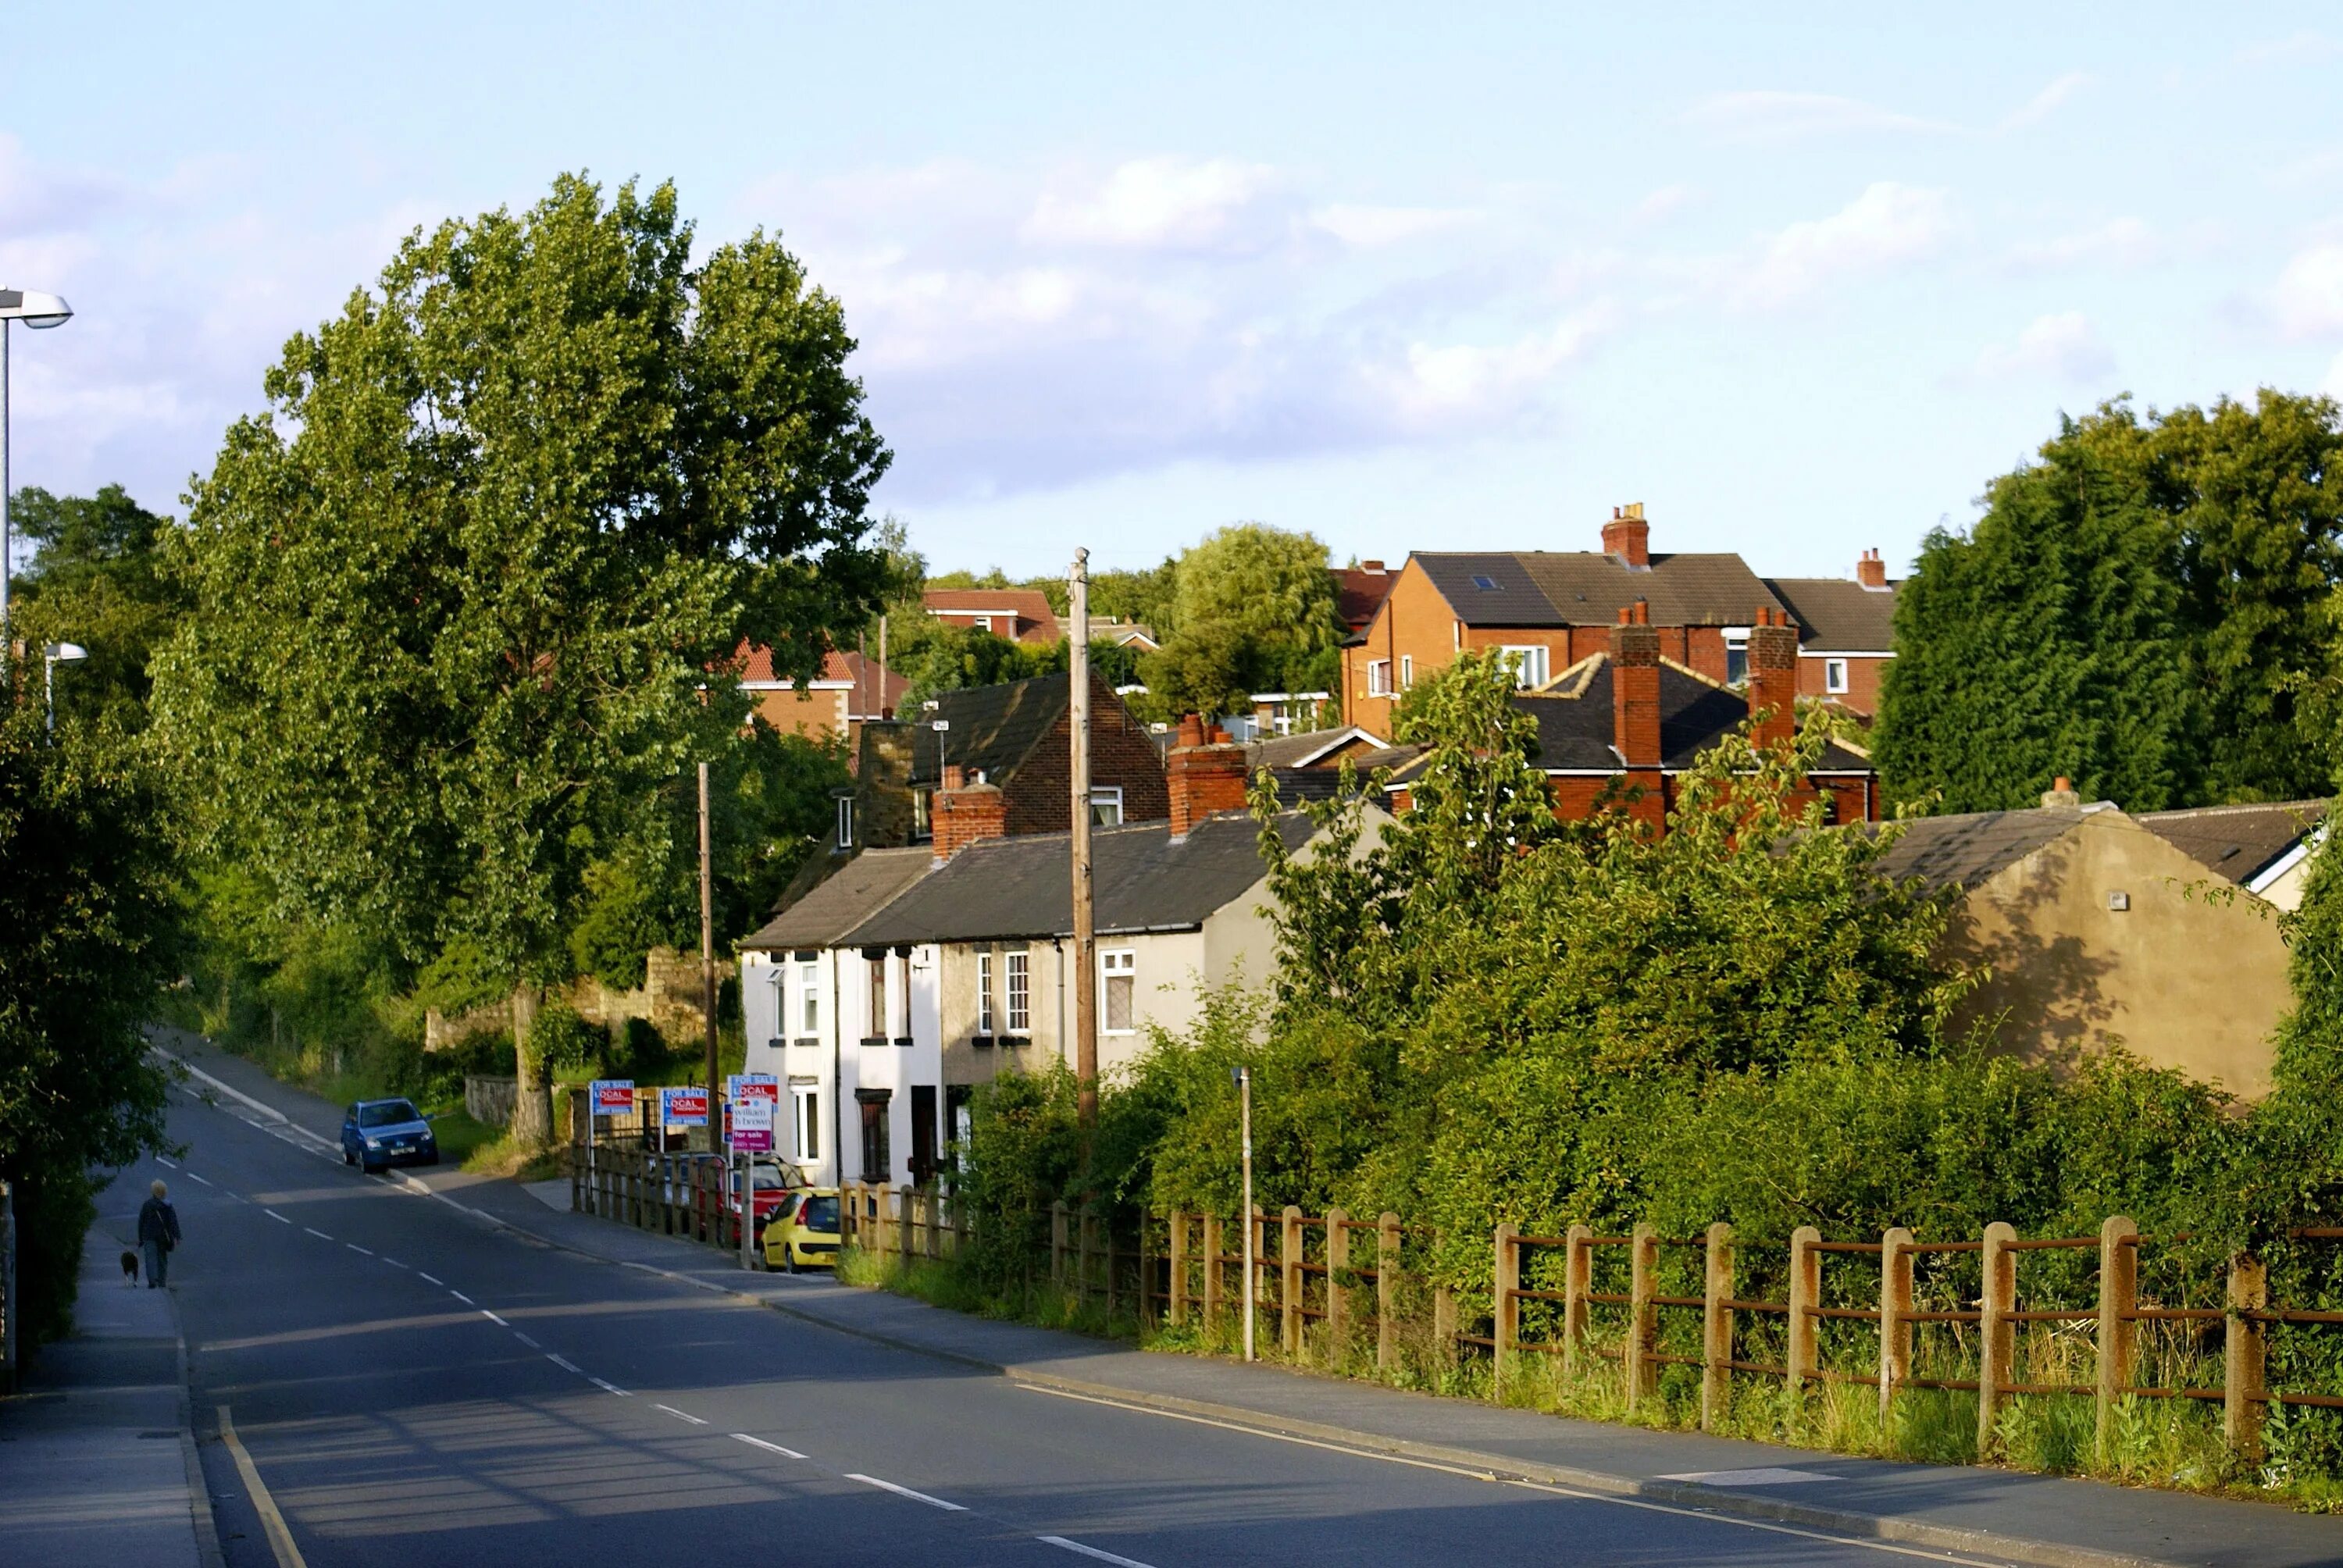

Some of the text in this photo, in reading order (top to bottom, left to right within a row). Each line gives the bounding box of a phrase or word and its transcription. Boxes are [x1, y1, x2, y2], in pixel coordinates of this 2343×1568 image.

[734, 1086, 768, 1095] LOCAL
[665, 1099, 698, 1108] LOCAL
[734, 1108, 766, 1117] william
